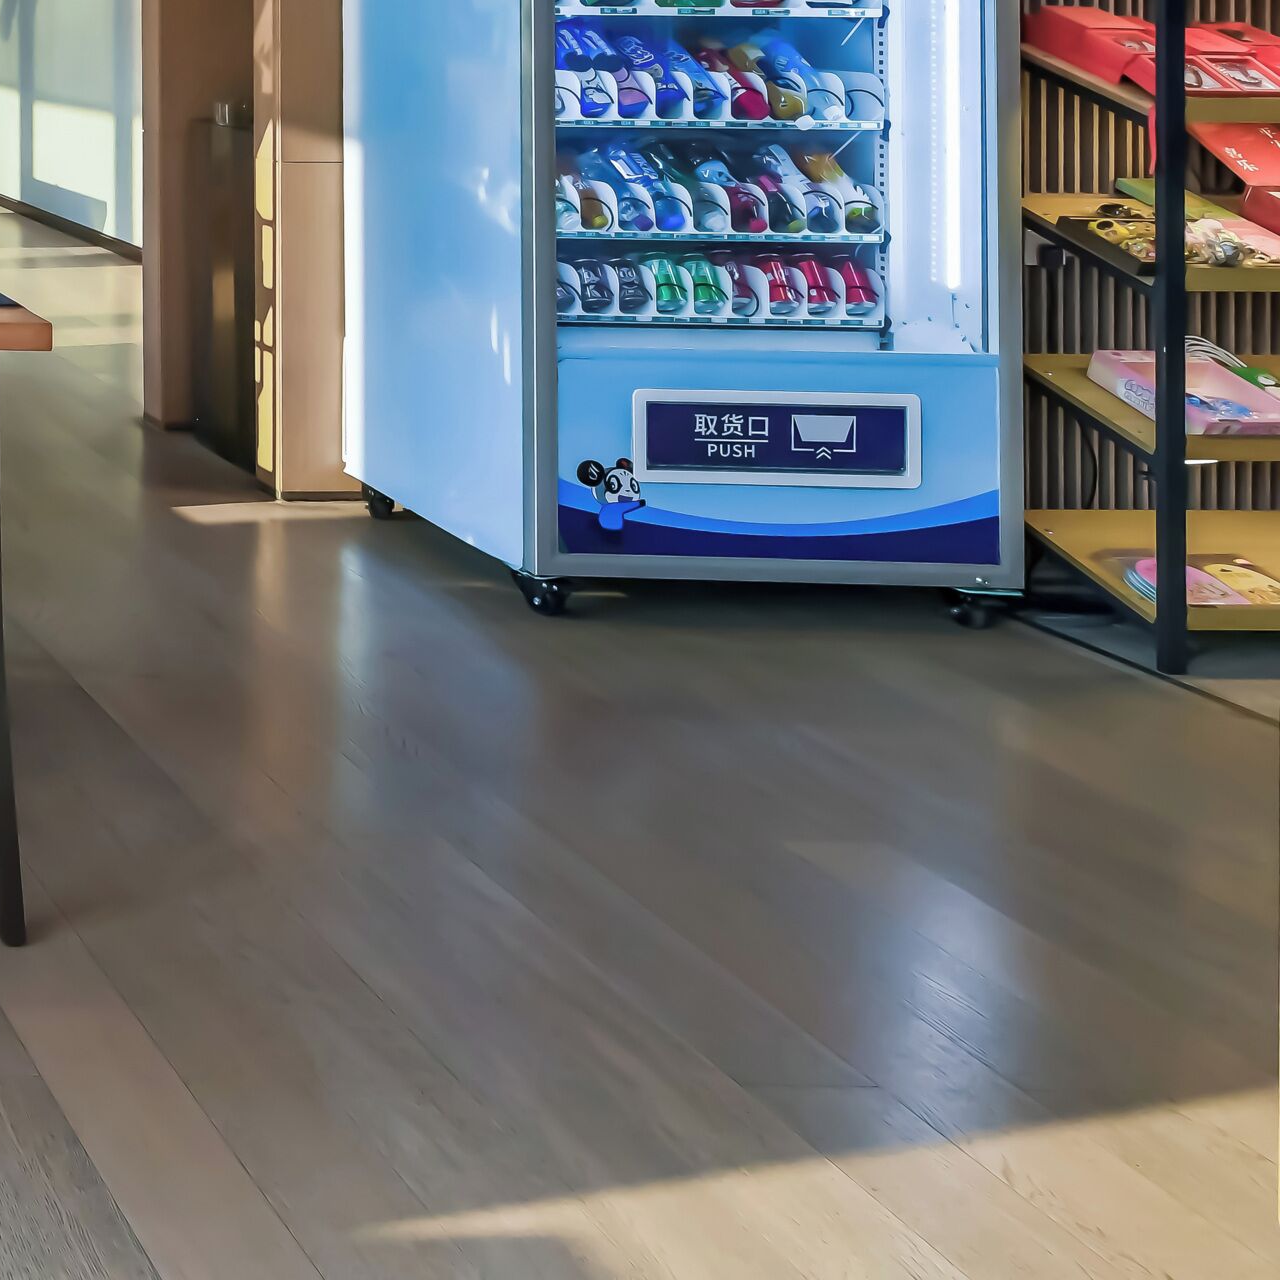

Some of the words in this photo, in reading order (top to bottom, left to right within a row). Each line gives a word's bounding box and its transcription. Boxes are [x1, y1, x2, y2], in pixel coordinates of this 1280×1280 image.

[694, 413, 769, 437] 取货口
[707, 444, 756, 459] PUSH
